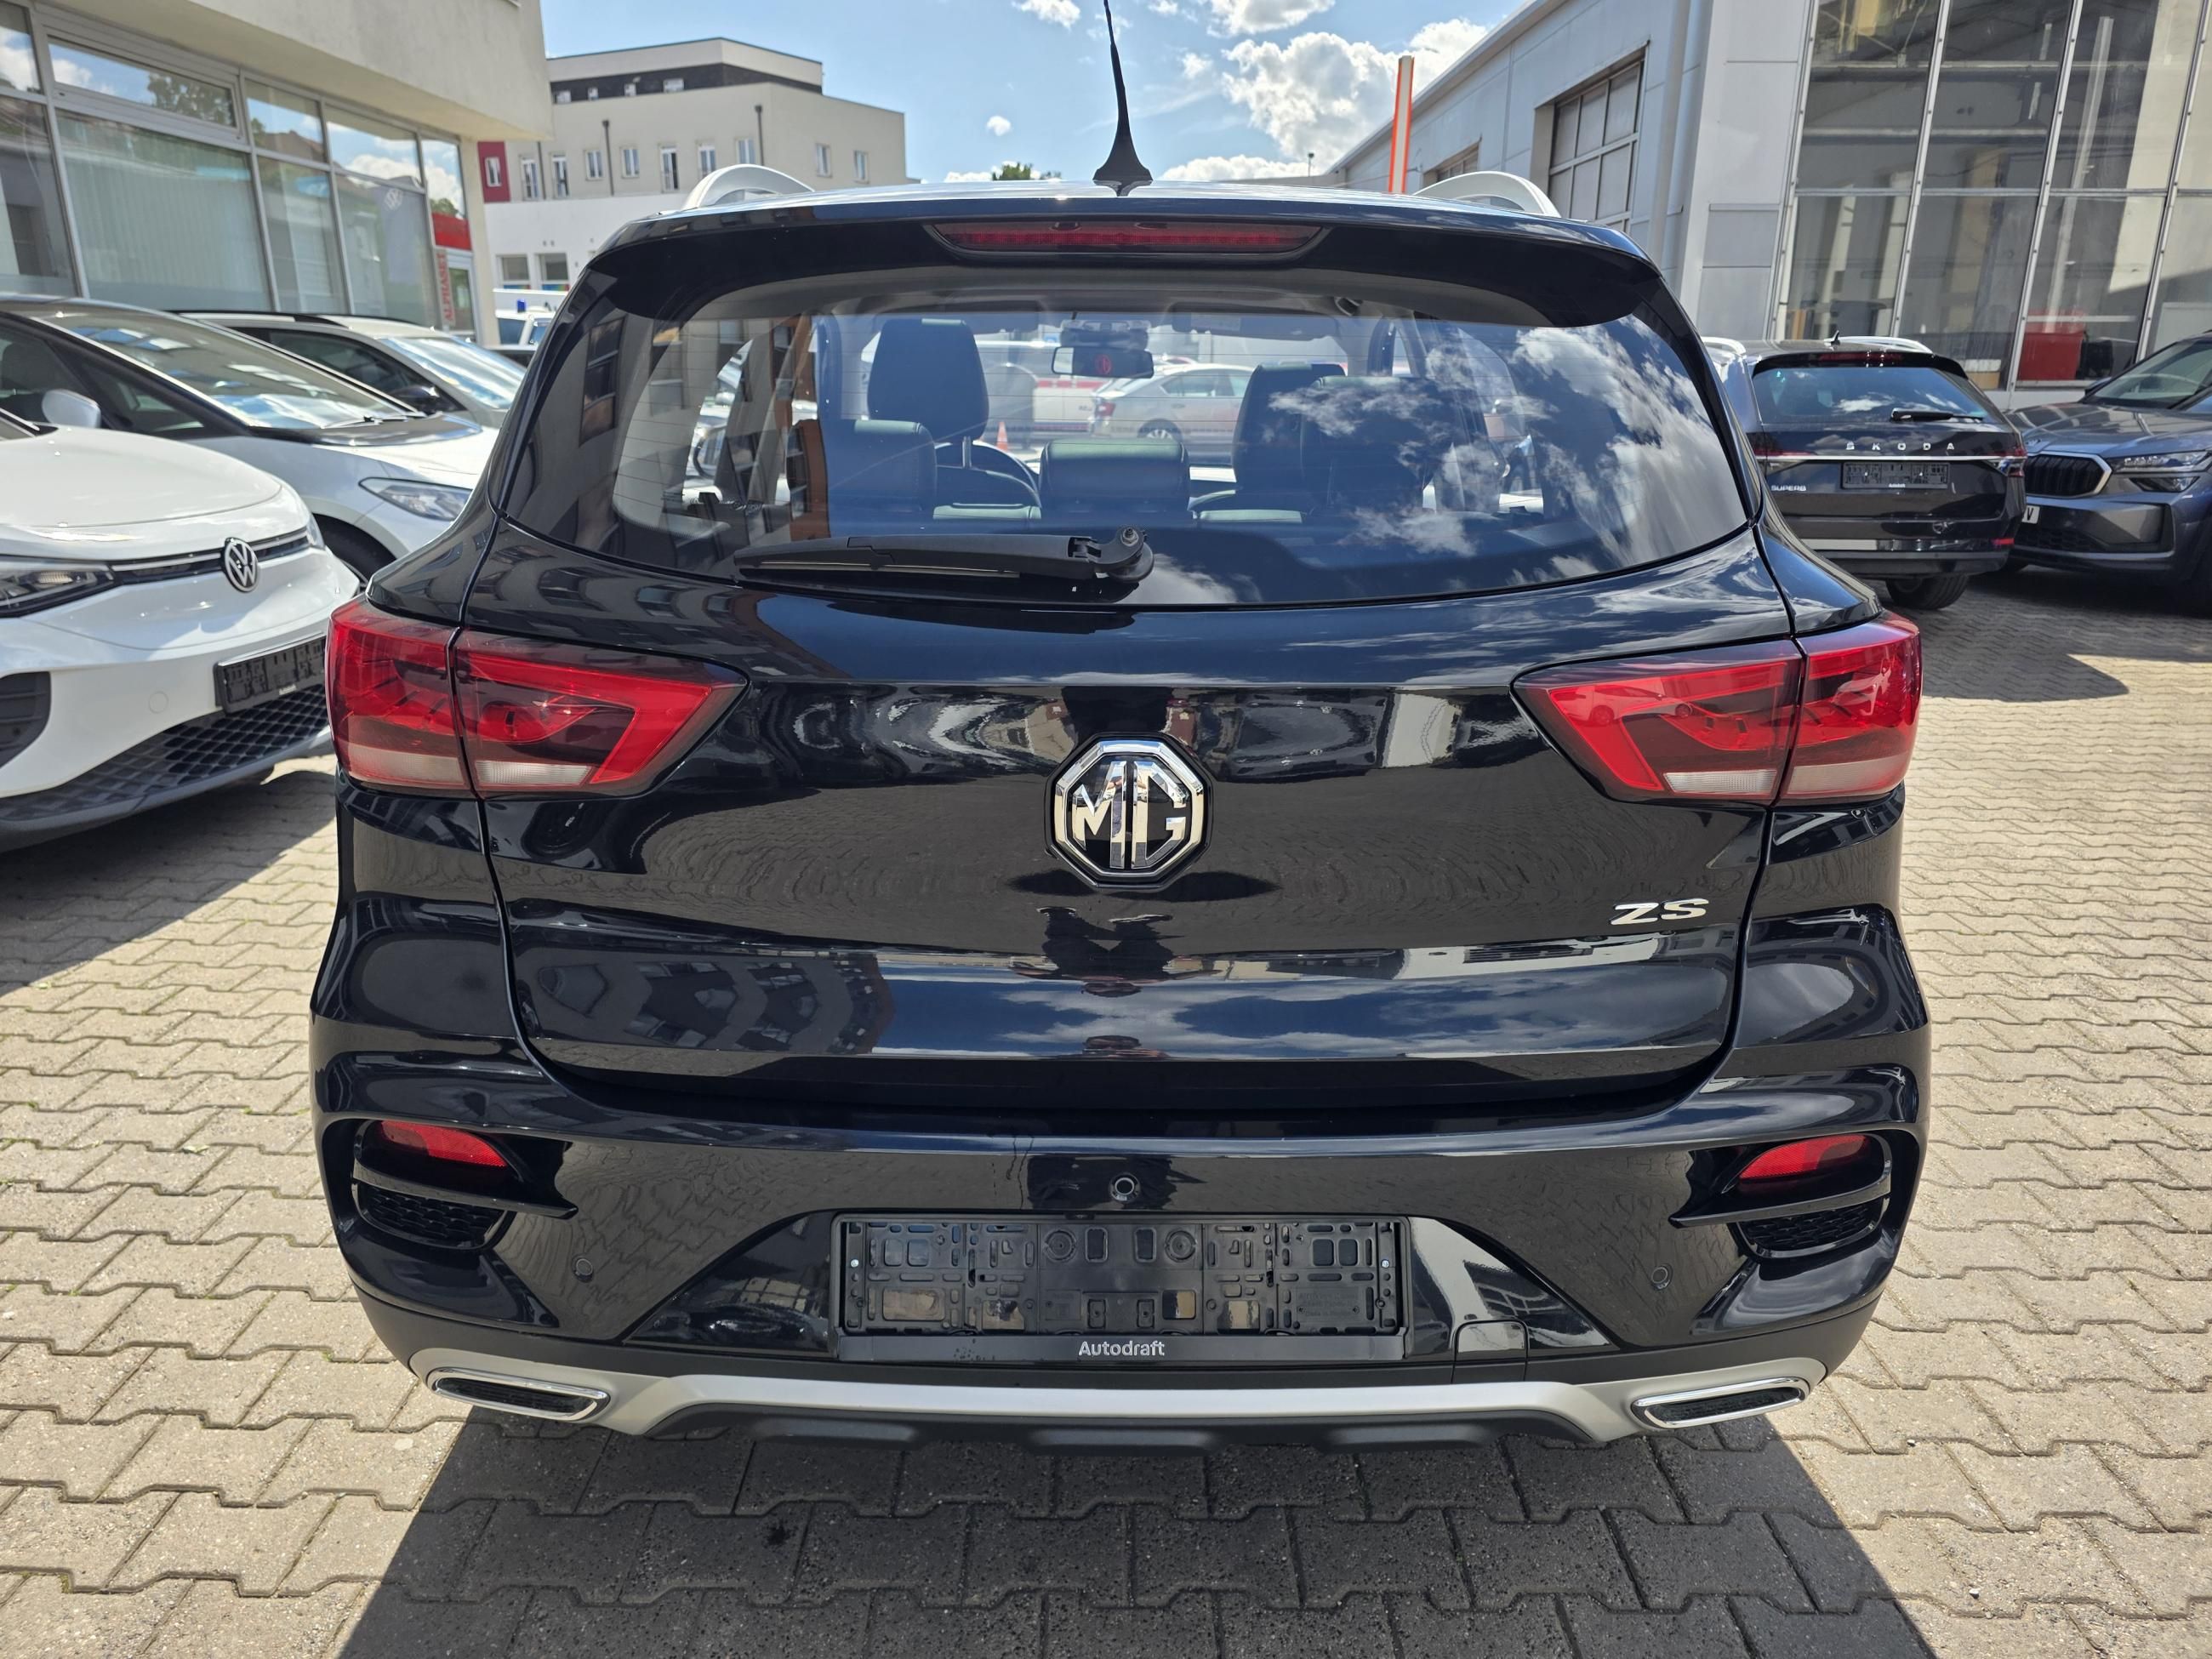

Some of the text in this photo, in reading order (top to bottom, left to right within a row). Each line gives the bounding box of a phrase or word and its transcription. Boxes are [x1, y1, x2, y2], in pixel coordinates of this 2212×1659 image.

[1071, 761, 1187, 869] MG
[1611, 898, 1709, 926] ZS
[1078, 1340, 1166, 1357] Autodraft
